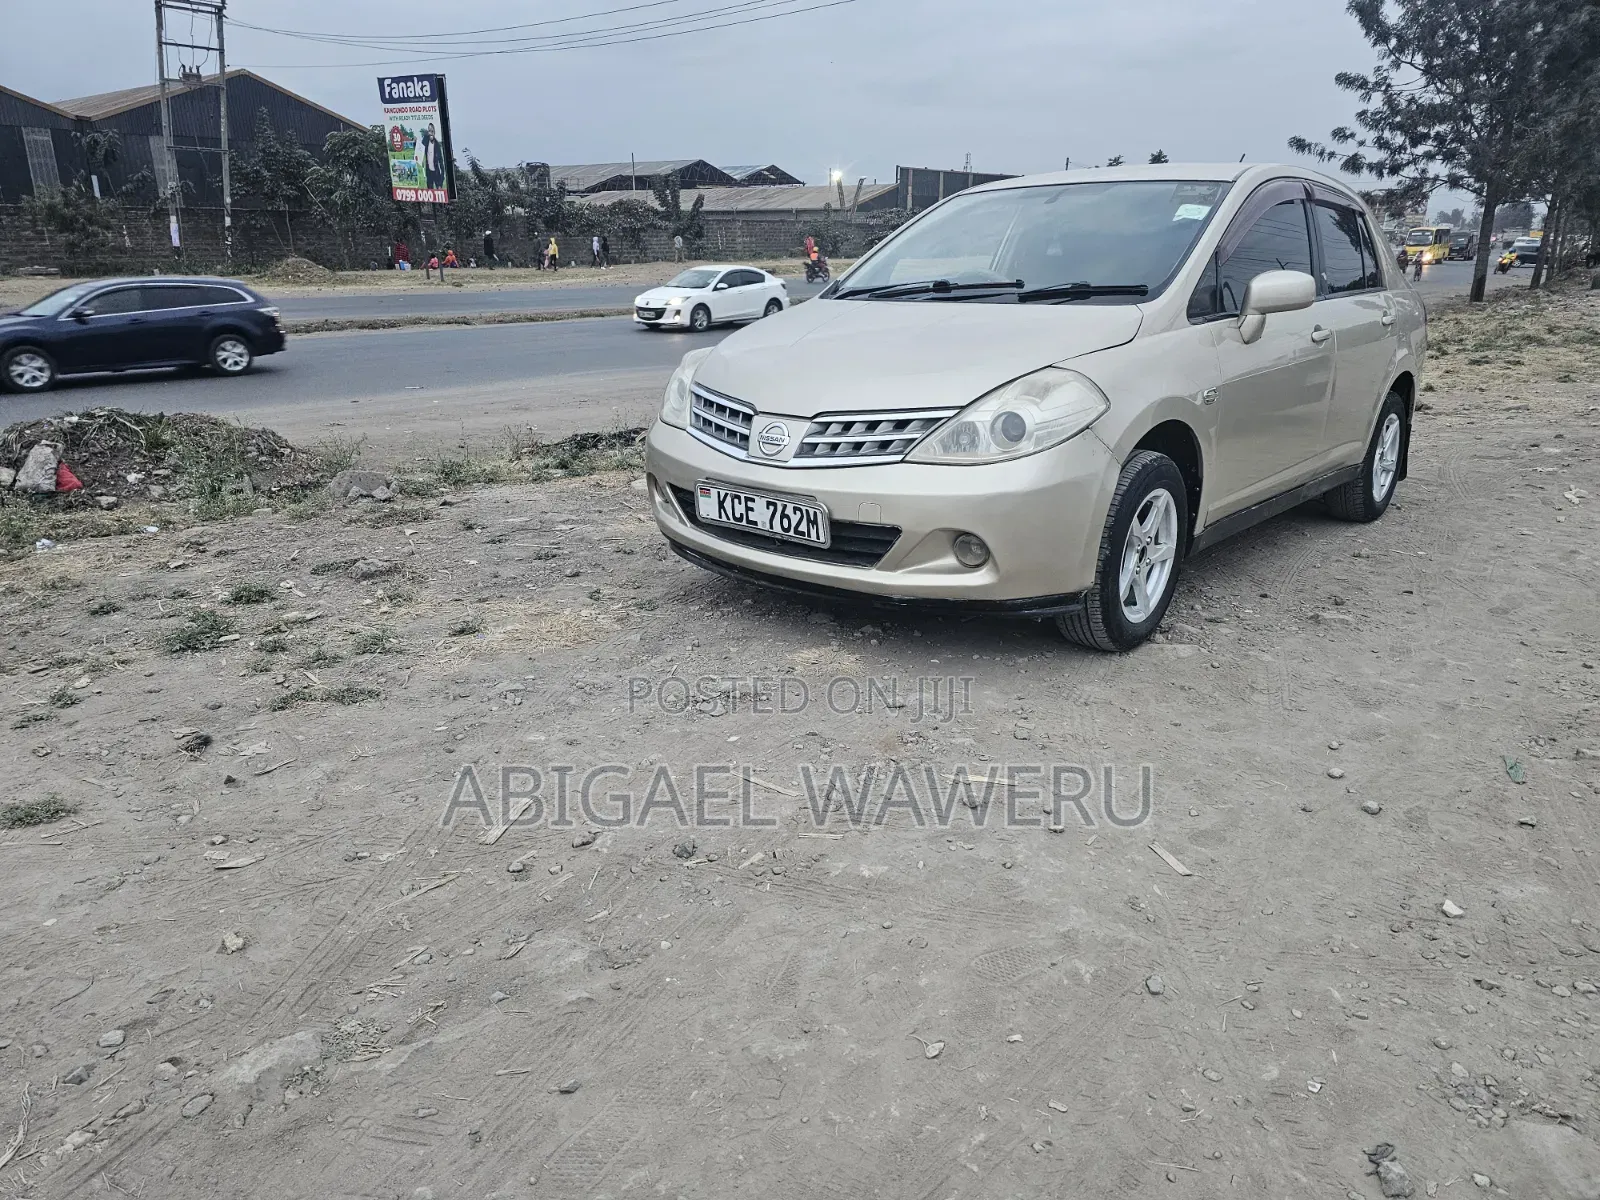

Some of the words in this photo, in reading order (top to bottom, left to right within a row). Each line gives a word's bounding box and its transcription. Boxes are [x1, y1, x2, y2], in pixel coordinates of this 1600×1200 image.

[384, 77, 431, 98] Fanaka
[396, 189, 416, 201] 0799
[417, 190, 434, 202] 000
[435, 191, 445, 202] 111
[760, 434, 786, 443] NISSAN
[717, 490, 759, 527] KCE
[766, 500, 821, 541] 762M
